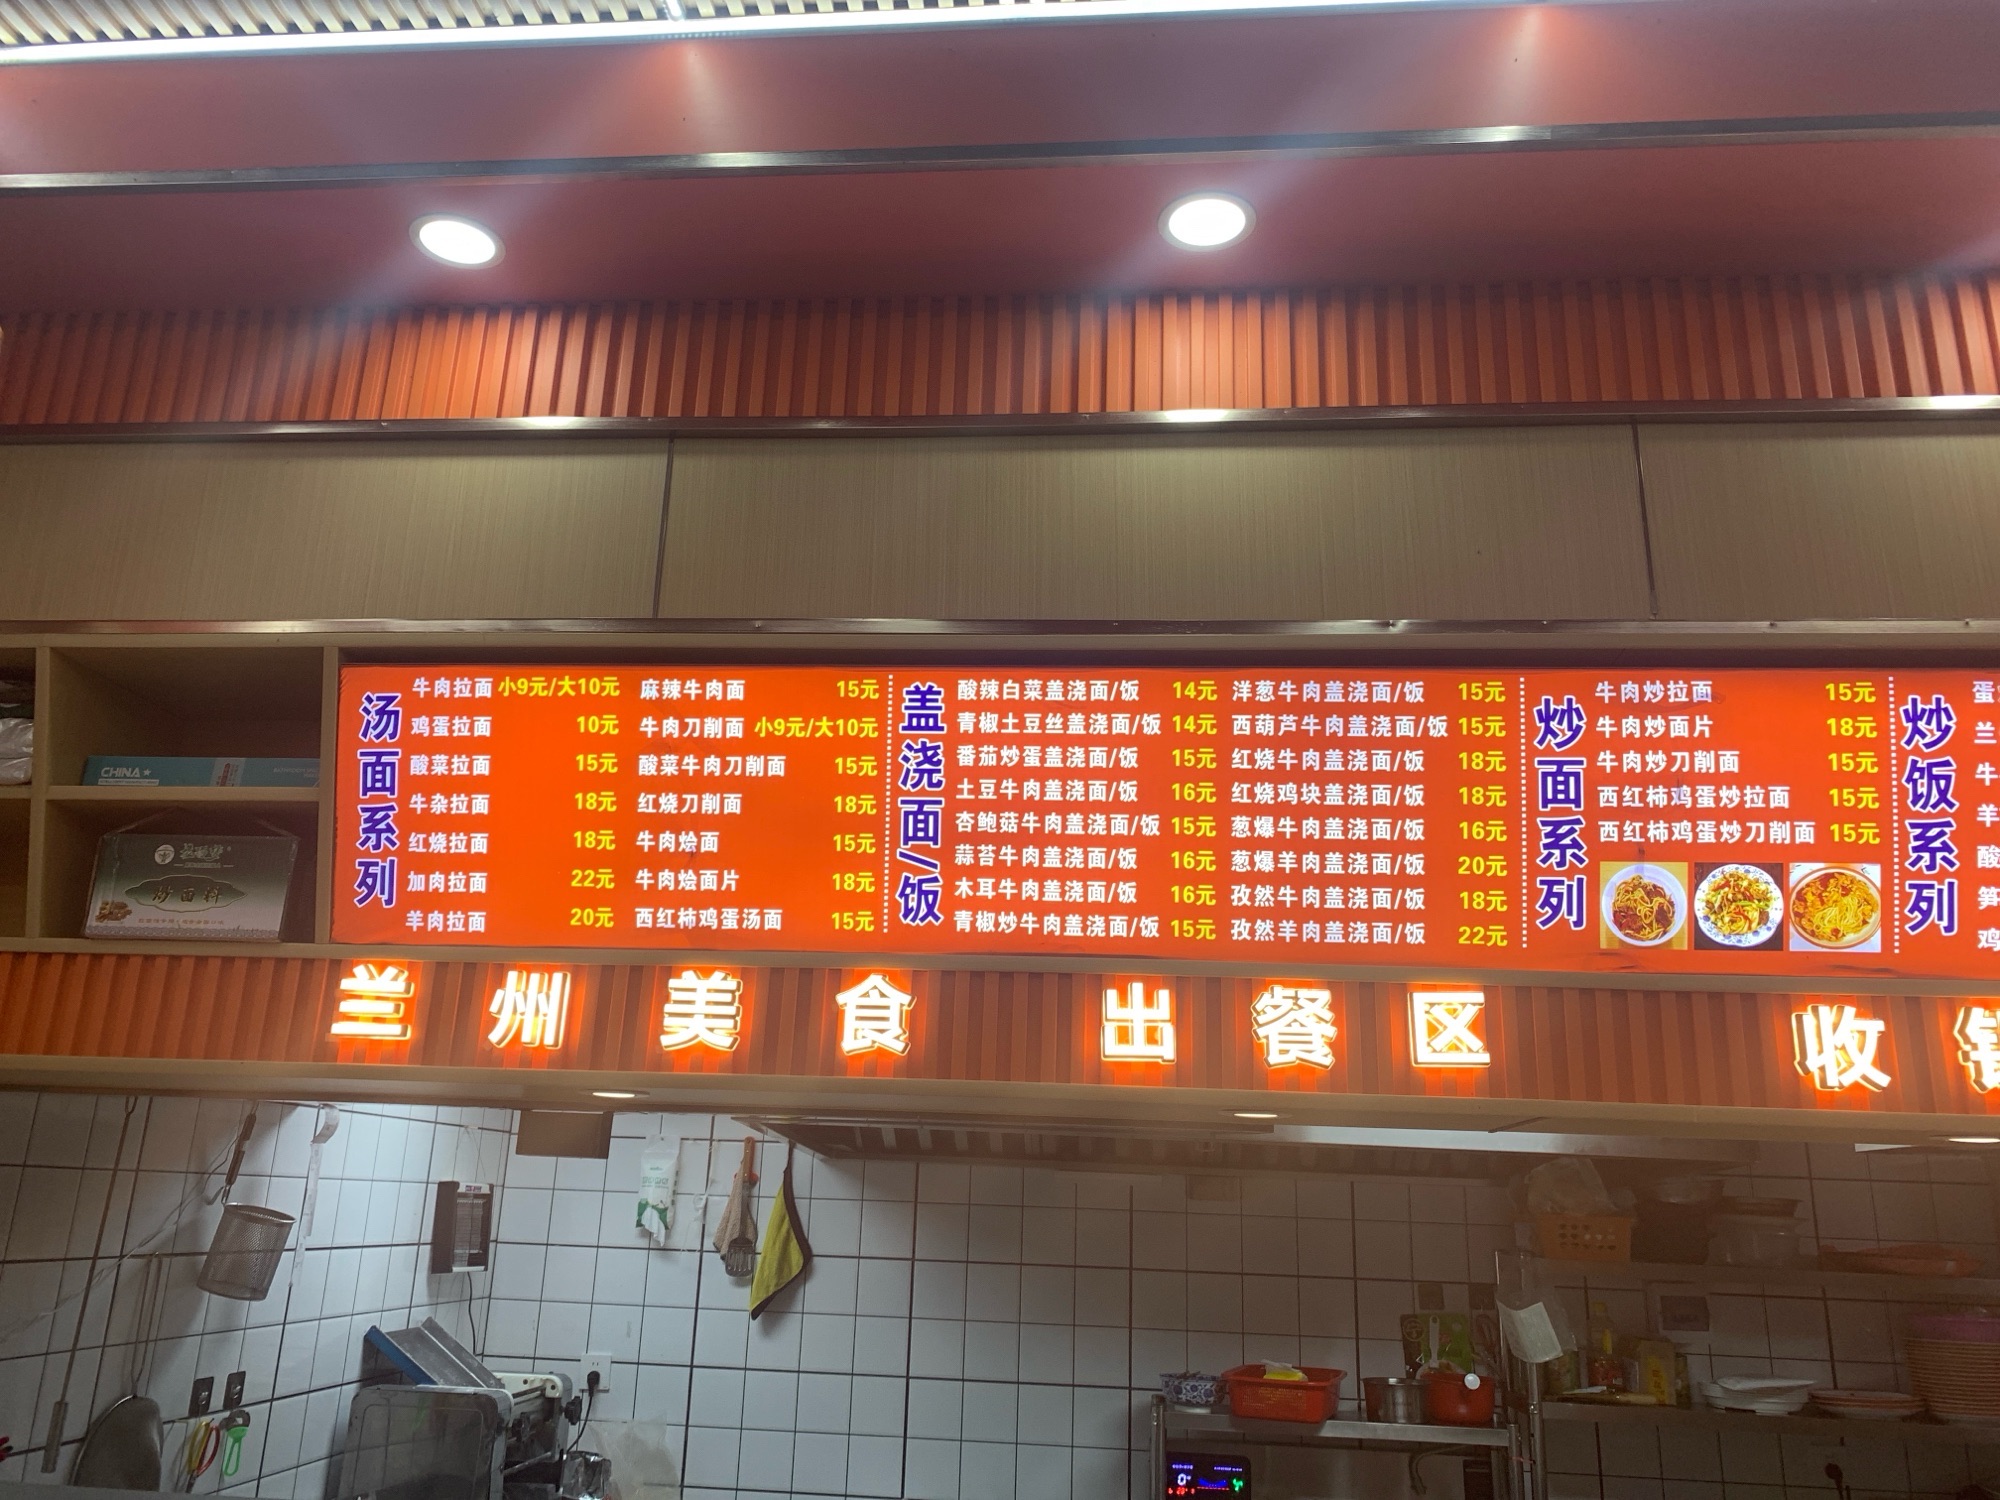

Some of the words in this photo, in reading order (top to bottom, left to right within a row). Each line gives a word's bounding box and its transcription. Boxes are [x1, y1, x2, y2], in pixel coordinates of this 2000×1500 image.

[412, 676, 494, 699] 牛肉拉面
[497, 675, 621, 697] 小9元/大10元
[640, 678, 745, 701] 麻辣牛肉面
[836, 679, 880, 700] 15元
[957, 678, 1140, 702] 酸辣白菜盖浇面/饭
[1172, 680, 1218, 701] 14元
[1232, 679, 1425, 703] 洋葱牛肉盖浇面/饭
[1458, 681, 1506, 703] 15元
[1594, 679, 1713, 704] 牛肉炒拉面
[1825, 681, 1877, 703] 15元
[1972, 681, 2000, 703] 蛋
[410, 715, 492, 737] 鸡蛋拉面
[576, 714, 620, 735] 10元
[639, 715, 745, 739] 牛肉刀削面
[754, 715, 879, 738] 小9元/大10元
[956, 711, 1162, 736] 青椒土豆丝盖浇面/饭
[1172, 713, 1218, 735] 14元
[1231, 713, 1449, 738] 西葫芦牛肉盖浇面/饭
[1458, 715, 1507, 738] 15元
[1595, 714, 1714, 739] 牛肉炒面片
[1826, 716, 1878, 739] 18元
[1974, 721, 2000, 743] 兰
[409, 753, 491, 776] 酸菜拉面
[575, 752, 619, 774] 15元
[638, 753, 787, 777] 酸菜牛肉刀削面
[834, 755, 878, 777] 15元
[956, 744, 1139, 769] 番茄炒蛋盖浇面/饭
[1171, 747, 1217, 769] 15元
[1231, 747, 1425, 772] 红烧牛肉盖浇面/饭
[1458, 750, 1507, 773] 18元
[1596, 749, 1740, 774] 牛肉炒刀削面
[1827, 751, 1879, 774] 15元
[100, 767, 141, 778] CHINA
[1975, 762, 2000, 786] 牛
[354, 691, 402, 908] 汤面系列
[955, 777, 1138, 803] 土豆牛肉盖浇面/饭
[1171, 782, 1217, 803] 16元
[1230, 781, 1425, 807] 红烧鸡块盖浇面/饭
[1458, 785, 1507, 807] 18元
[1596, 784, 1790, 809] 西红柿鸡蛋炒拉面
[1829, 787, 1880, 809] 15元
[409, 792, 490, 815] 牛杂拉面
[574, 791, 617, 812] 18元
[637, 792, 743, 815] 红烧刀削面
[833, 794, 877, 815] 18元
[896, 681, 946, 927] 盖浇面/饭
[1534, 695, 1588, 930] 炒面系列
[1900, 695, 1959, 936] 炒饭系列
[1976, 803, 2000, 827] 羊
[955, 810, 1161, 837] 杏鲍菇牛肉盖浇面/饭
[1171, 815, 1217, 837] 15元
[1230, 815, 1425, 841] 葱爆牛肉盖浇面/饭
[1459, 820, 1508, 842] 16元
[1597, 819, 1816, 845] 西红柿鸡蛋炒刀削面
[1829, 822, 1881, 845] 15元
[408, 831, 489, 854] 红烧拉面
[573, 829, 616, 851] 18元
[635, 829, 720, 853] 牛肉烩面
[833, 833, 877, 854] 15元
[954, 843, 1138, 870] 蒜苔牛肉盖浇面/饭
[1171, 850, 1217, 872] 16元
[1230, 849, 1426, 876] 葱爆羊肉盖浇面/饭
[1457, 855, 1508, 877] 20元
[406, 870, 488, 894] 加肉拉面
[570, 868, 615, 889] 22元
[635, 868, 740, 892] 牛肉烩面片
[832, 871, 876, 893] 18元
[954, 876, 1137, 904] 木耳牛肉盖浇面/饭
[1170, 884, 1217, 906] 16元
[1230, 883, 1426, 910] 孜然牛肉盖浇面/饭
[1459, 890, 1508, 912] 18元
[405, 909, 487, 933] 羊肉拉面
[569, 907, 615, 928] 20元
[634, 907, 783, 931] 西红柿鸡蛋汤面
[831, 910, 875, 932] 15元
[953, 909, 1160, 938] 青椒炒牛肉盖浇面/饭
[1170, 918, 1217, 940] 15元
[1230, 917, 1426, 945] 孜然羊肉盖浇面/饭
[1458, 925, 1508, 947] 22元
[329, 963, 916, 1057] 兰州美食
[1101, 981, 1492, 1069] 出餐区
